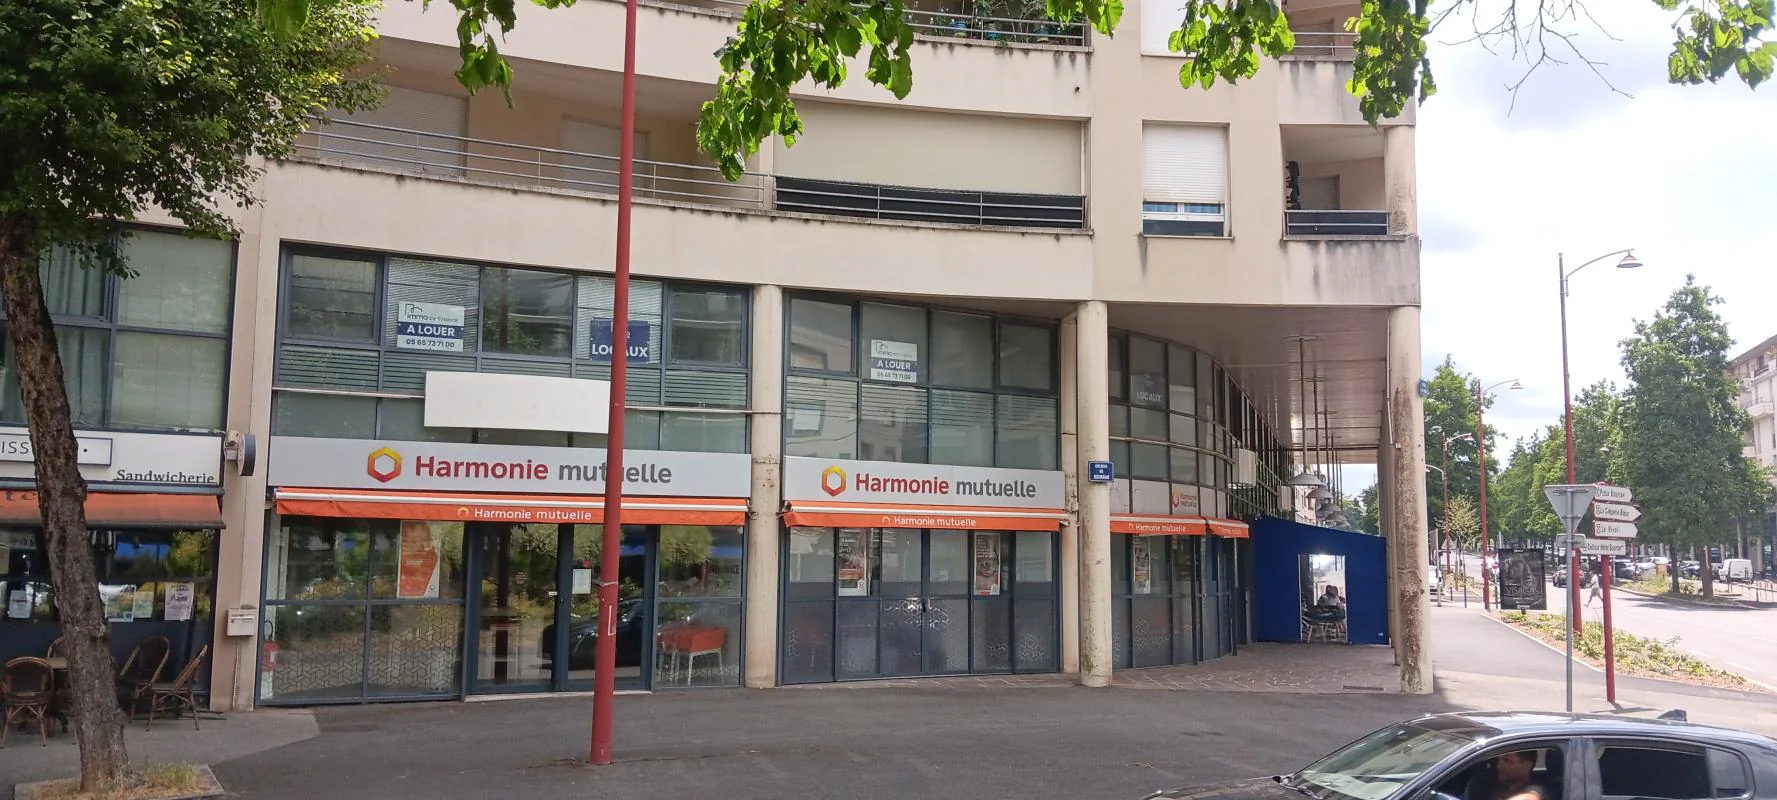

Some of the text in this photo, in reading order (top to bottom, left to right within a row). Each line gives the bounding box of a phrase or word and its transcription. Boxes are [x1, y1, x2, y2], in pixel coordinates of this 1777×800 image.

[406, 324, 455, 336] A LOUER
[591, 343, 649, 358] LOUX
[877, 359, 911, 370] A LOUER
[117, 469, 214, 483] Sandwicherie
[415, 455, 673, 484] Harmonie mutelle
[855, 473, 1036, 498] Harmonie mutuelle
[474, 508, 592, 520] Harmonie mutuelle
[894, 516, 977, 527] Harmonie mutuelle
